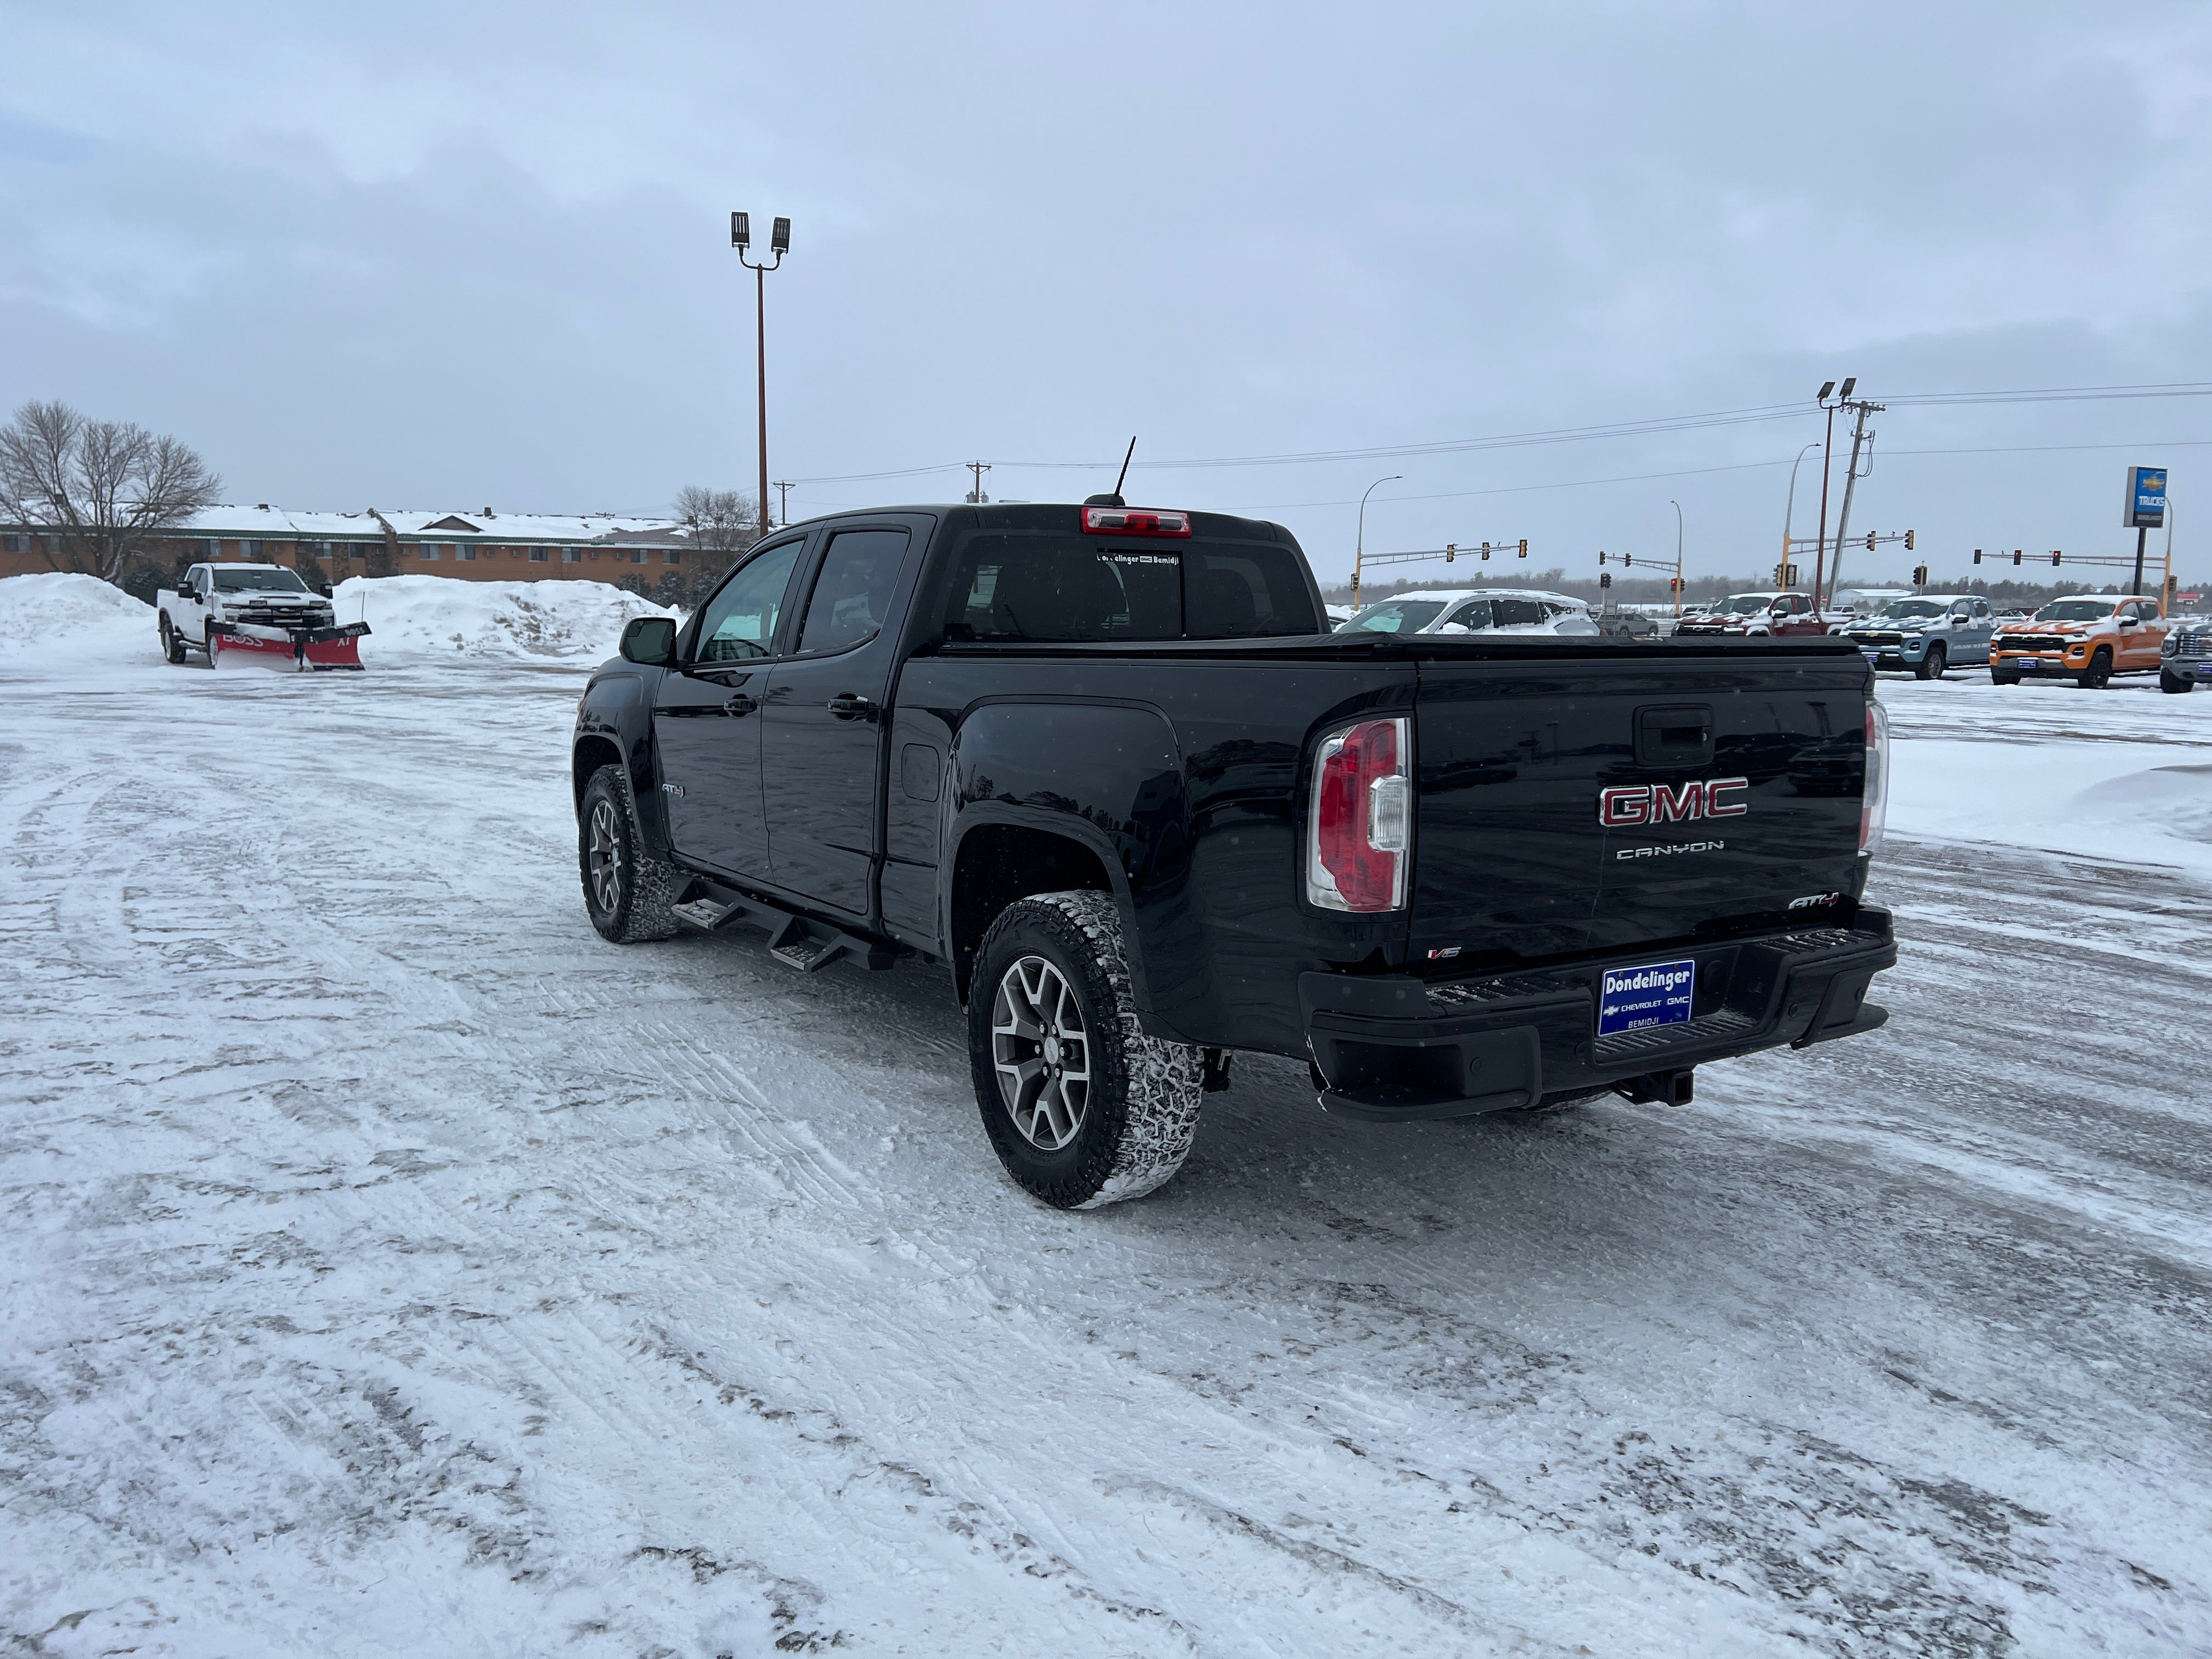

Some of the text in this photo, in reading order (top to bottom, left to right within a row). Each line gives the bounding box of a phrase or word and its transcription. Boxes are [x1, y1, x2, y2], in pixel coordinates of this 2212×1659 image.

[2138, 495, 2165, 506] TRUCKS
[1153, 556, 1179, 565] Bemidji
[223, 634, 263, 647] BOSS
[662, 783, 684, 798] AT4
[1599, 776, 1748, 827] GMC
[1616, 840, 1725, 860] CANYON
[1788, 892, 1839, 910] AT4
[1427, 946, 1462, 959] V6
[1606, 970, 1690, 994] Dondelinger
[1621, 996, 1689, 1012] CHEVROLET GMC
[1628, 1017, 1659, 1029] BEMIDJI
